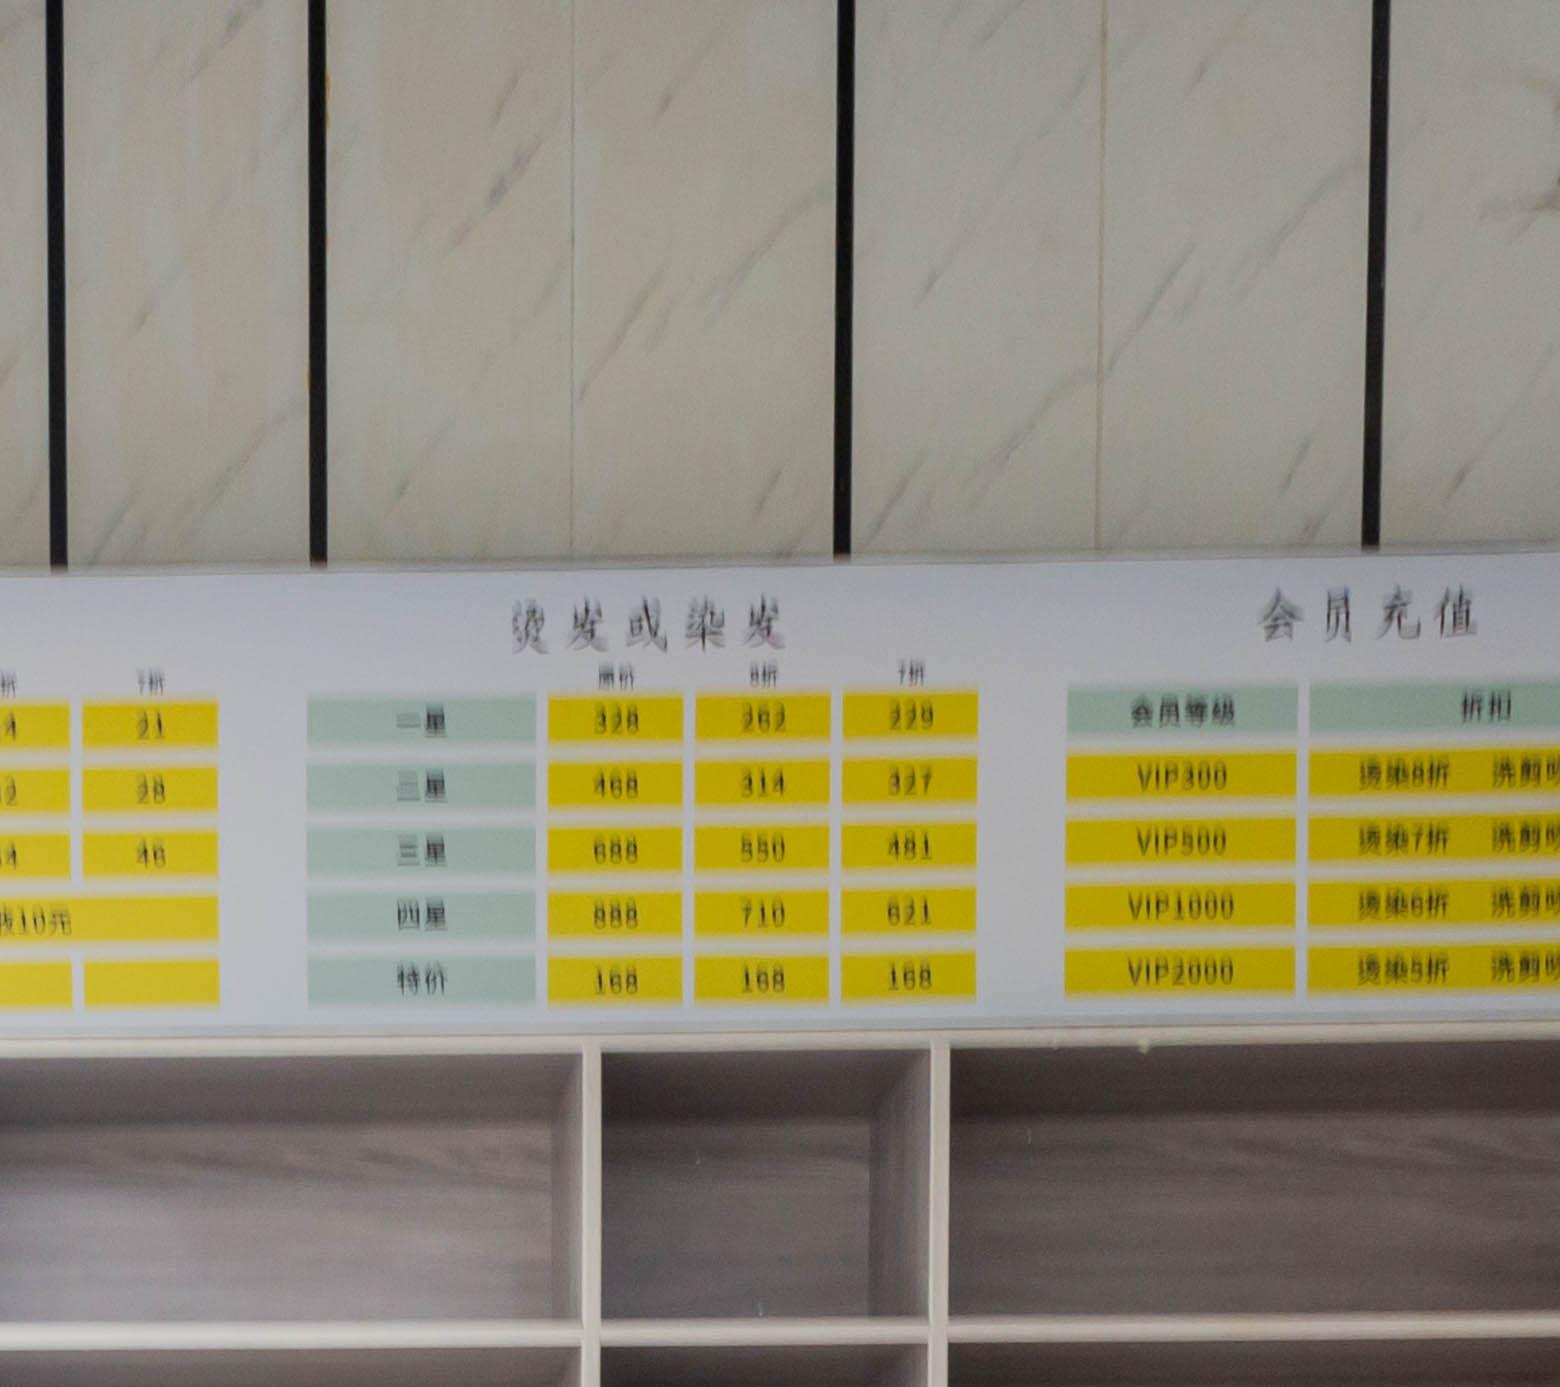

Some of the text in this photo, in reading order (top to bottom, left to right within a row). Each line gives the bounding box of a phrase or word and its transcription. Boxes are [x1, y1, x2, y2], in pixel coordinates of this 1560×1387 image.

[511, 594, 785, 654] 烫发或染发
[1257, 586, 1478, 643] 会员充值
[593, 701, 933, 735] 328 262 229
[1130, 690, 1512, 727] 会员等级 折扣
[136, 710, 166, 741] 21
[593, 769, 639, 798] 468
[888, 767, 932, 796] 327
[1137, 761, 1228, 792] VIP300
[1359, 759, 1448, 787] 烫染8折
[593, 831, 932, 863] 688 550 481
[1136, 827, 1227, 856] VIP500
[396, 899, 447, 931] 四星
[593, 895, 932, 928] 888 710 621
[1128, 892, 1234, 921] VIP1000
[396, 963, 447, 995] 特价
[593, 960, 932, 994] 168 168 168
[1127, 956, 1234, 985] VIP2000
